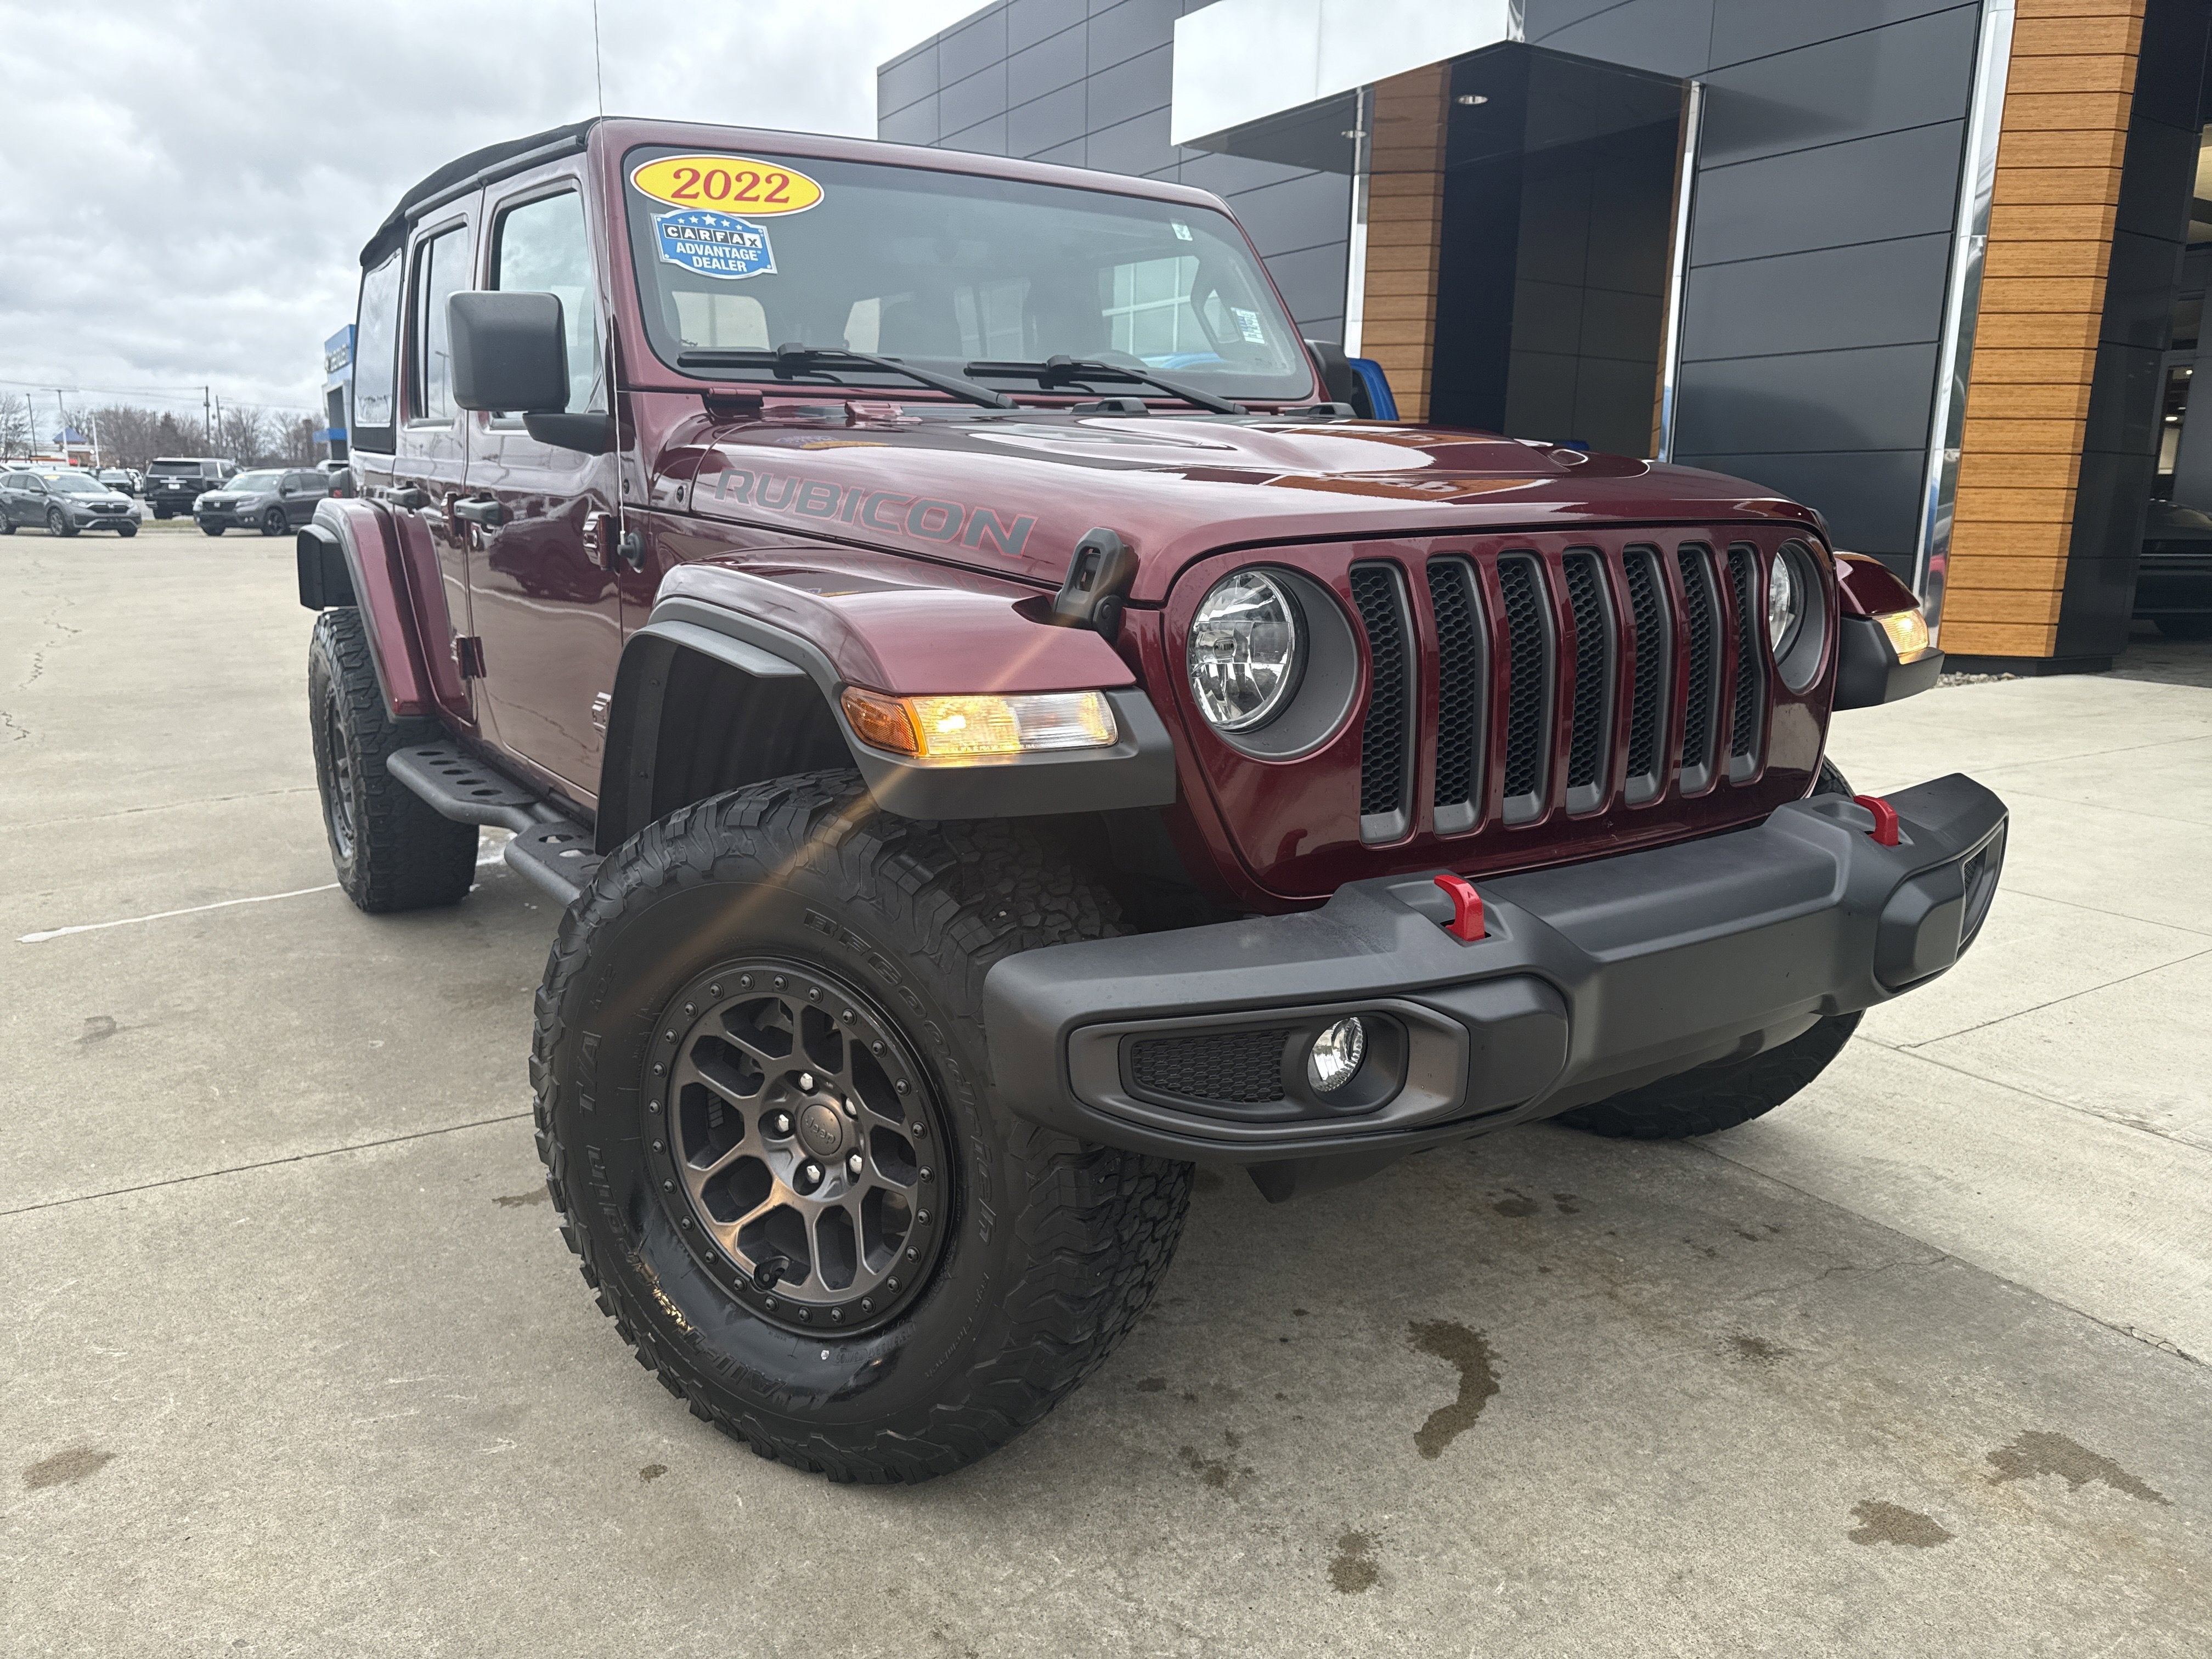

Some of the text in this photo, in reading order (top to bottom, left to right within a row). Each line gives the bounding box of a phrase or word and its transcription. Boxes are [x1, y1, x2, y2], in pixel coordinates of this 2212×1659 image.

[670, 167, 790, 204] 2022
[665, 225, 761, 248] CARFAX
[676, 241, 758, 262] ADVANTAGE
[692, 256, 747, 273] DEALER
[714, 467, 1039, 558] RUBICON
[804, 1116, 836, 1144] Jeep
